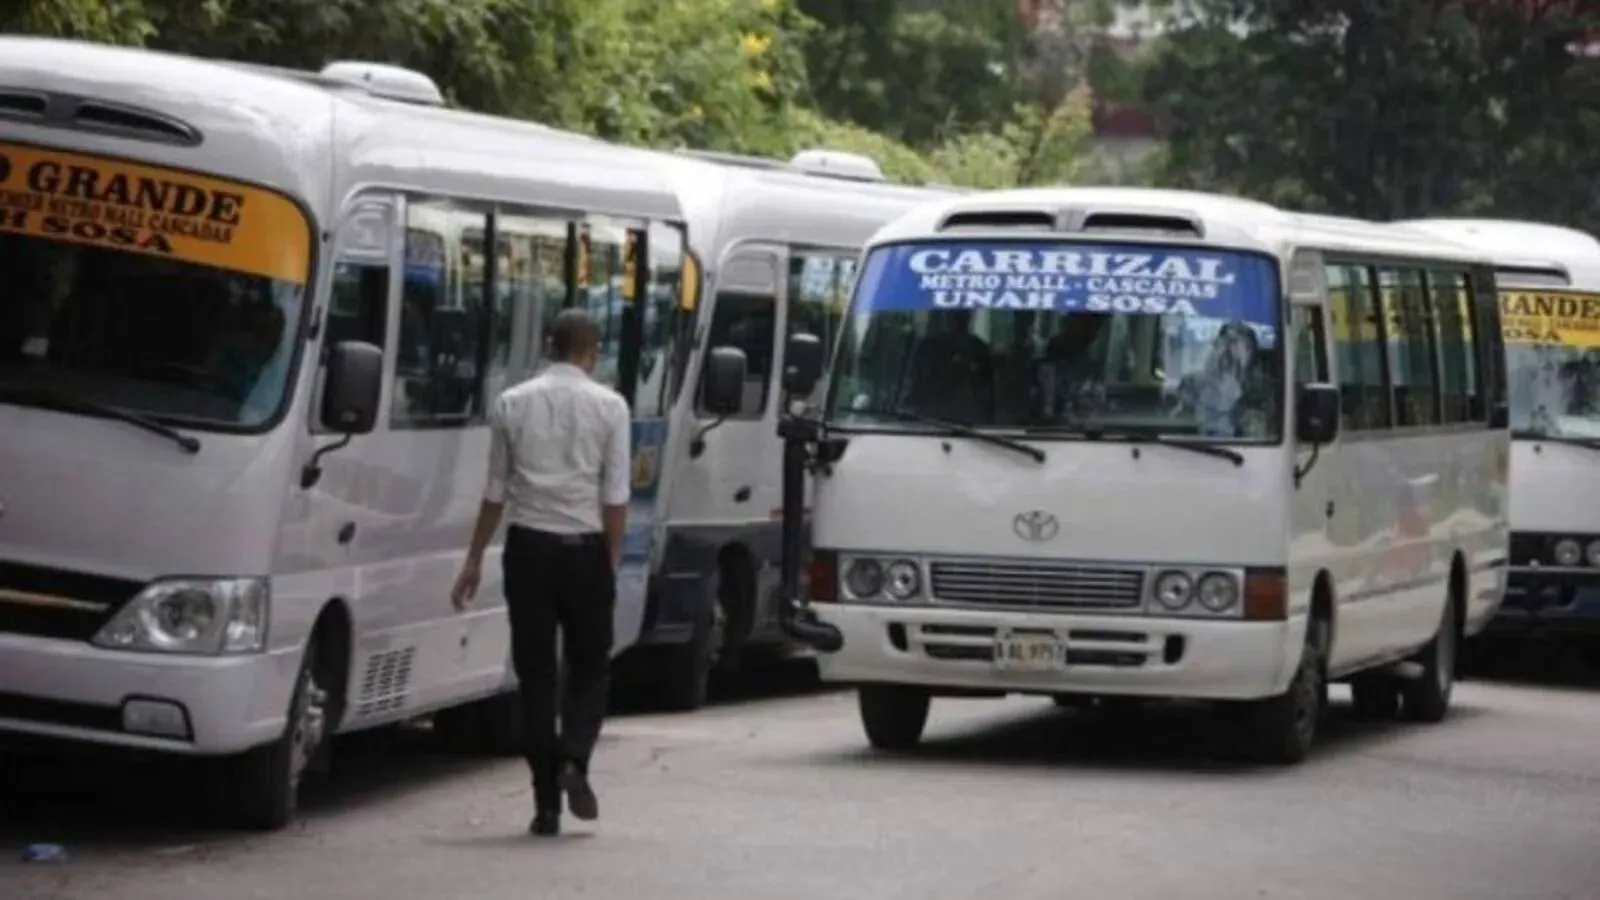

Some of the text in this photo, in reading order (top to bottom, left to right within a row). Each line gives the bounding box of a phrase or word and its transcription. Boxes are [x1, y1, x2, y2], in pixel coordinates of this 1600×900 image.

[27, 160, 244, 226] GRANDE
[41, 213, 173, 253] SOSA
[908, 249, 1236, 284] CARRIZAL
[920, 274, 1000, 291] METRO
[1005, 275, 1071, 291] MALL
[1086, 277, 1217, 299] CASCADAS
[933, 290, 1056, 309] UNAH
[1086, 294, 1199, 317] SOSA
